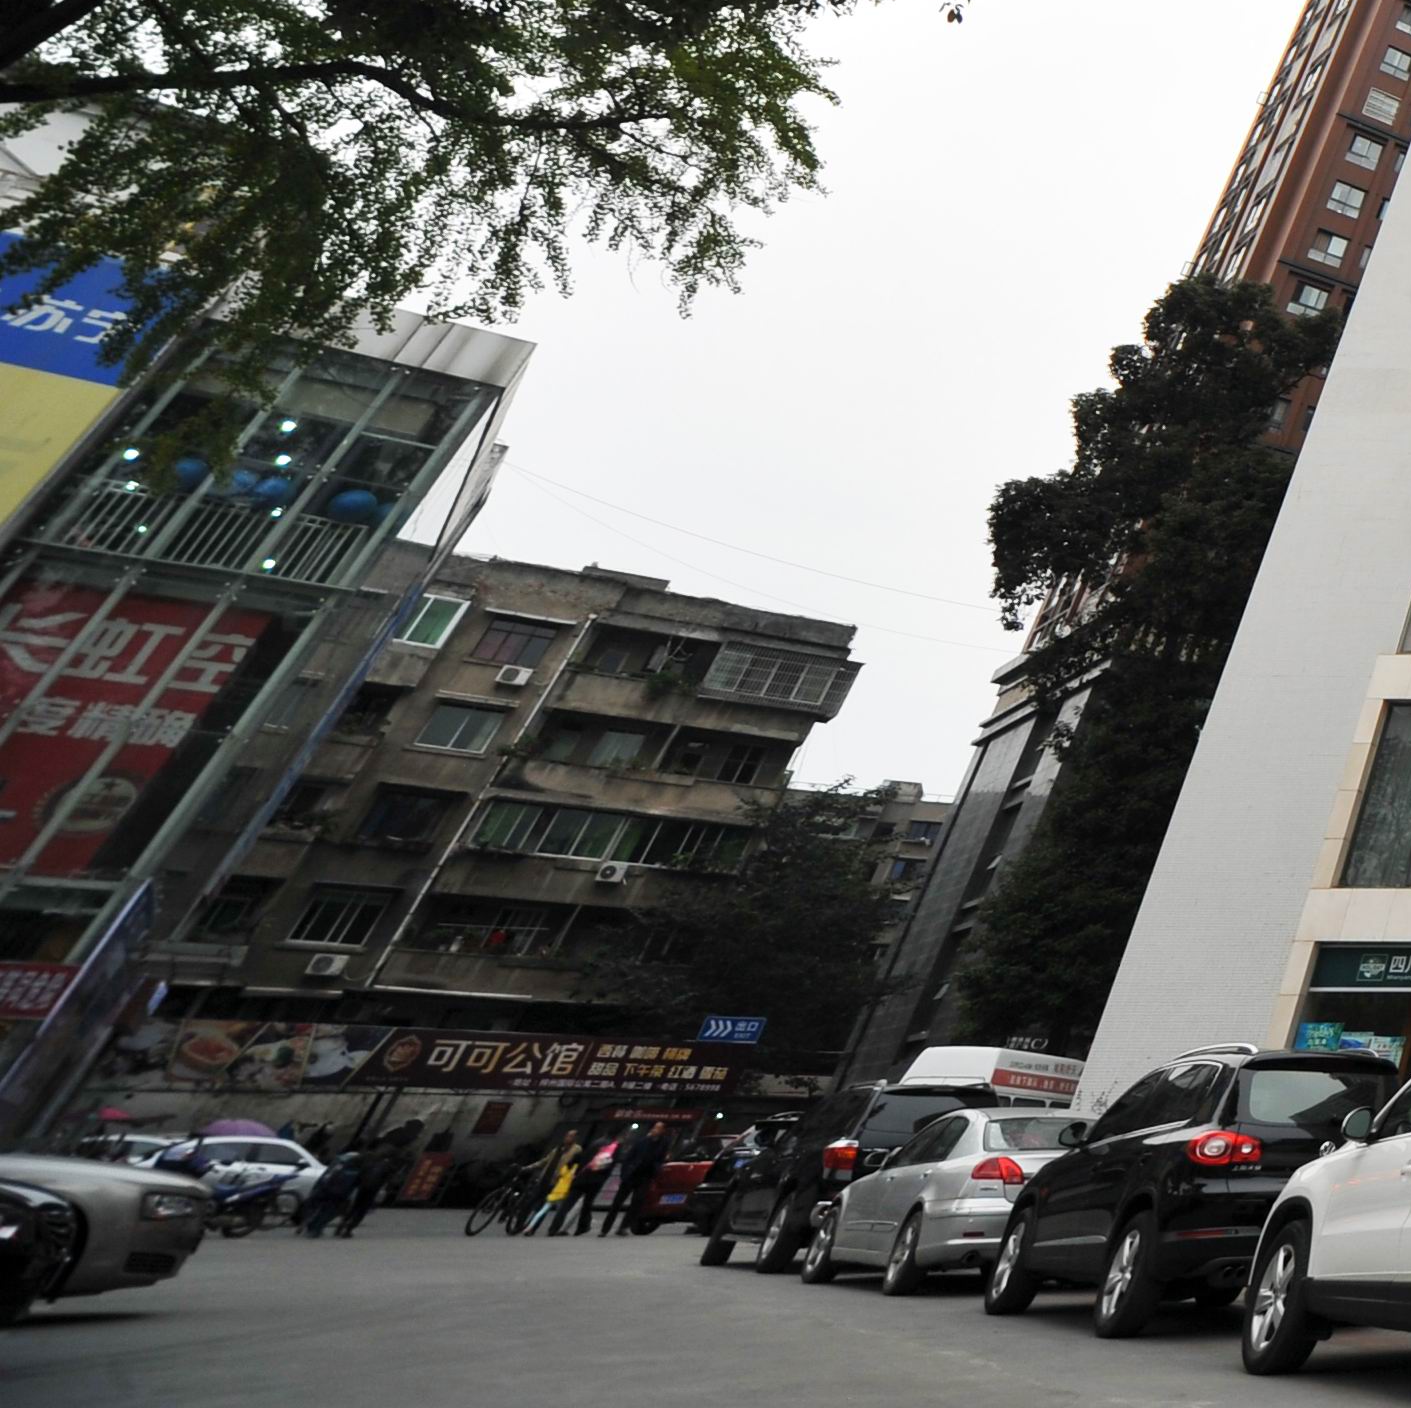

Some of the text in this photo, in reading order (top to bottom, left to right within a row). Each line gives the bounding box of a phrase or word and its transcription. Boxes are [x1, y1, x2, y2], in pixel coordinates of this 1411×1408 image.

[734, 1020, 760, 1032] 出口
[426, 1039, 584, 1075] 可可公馆
